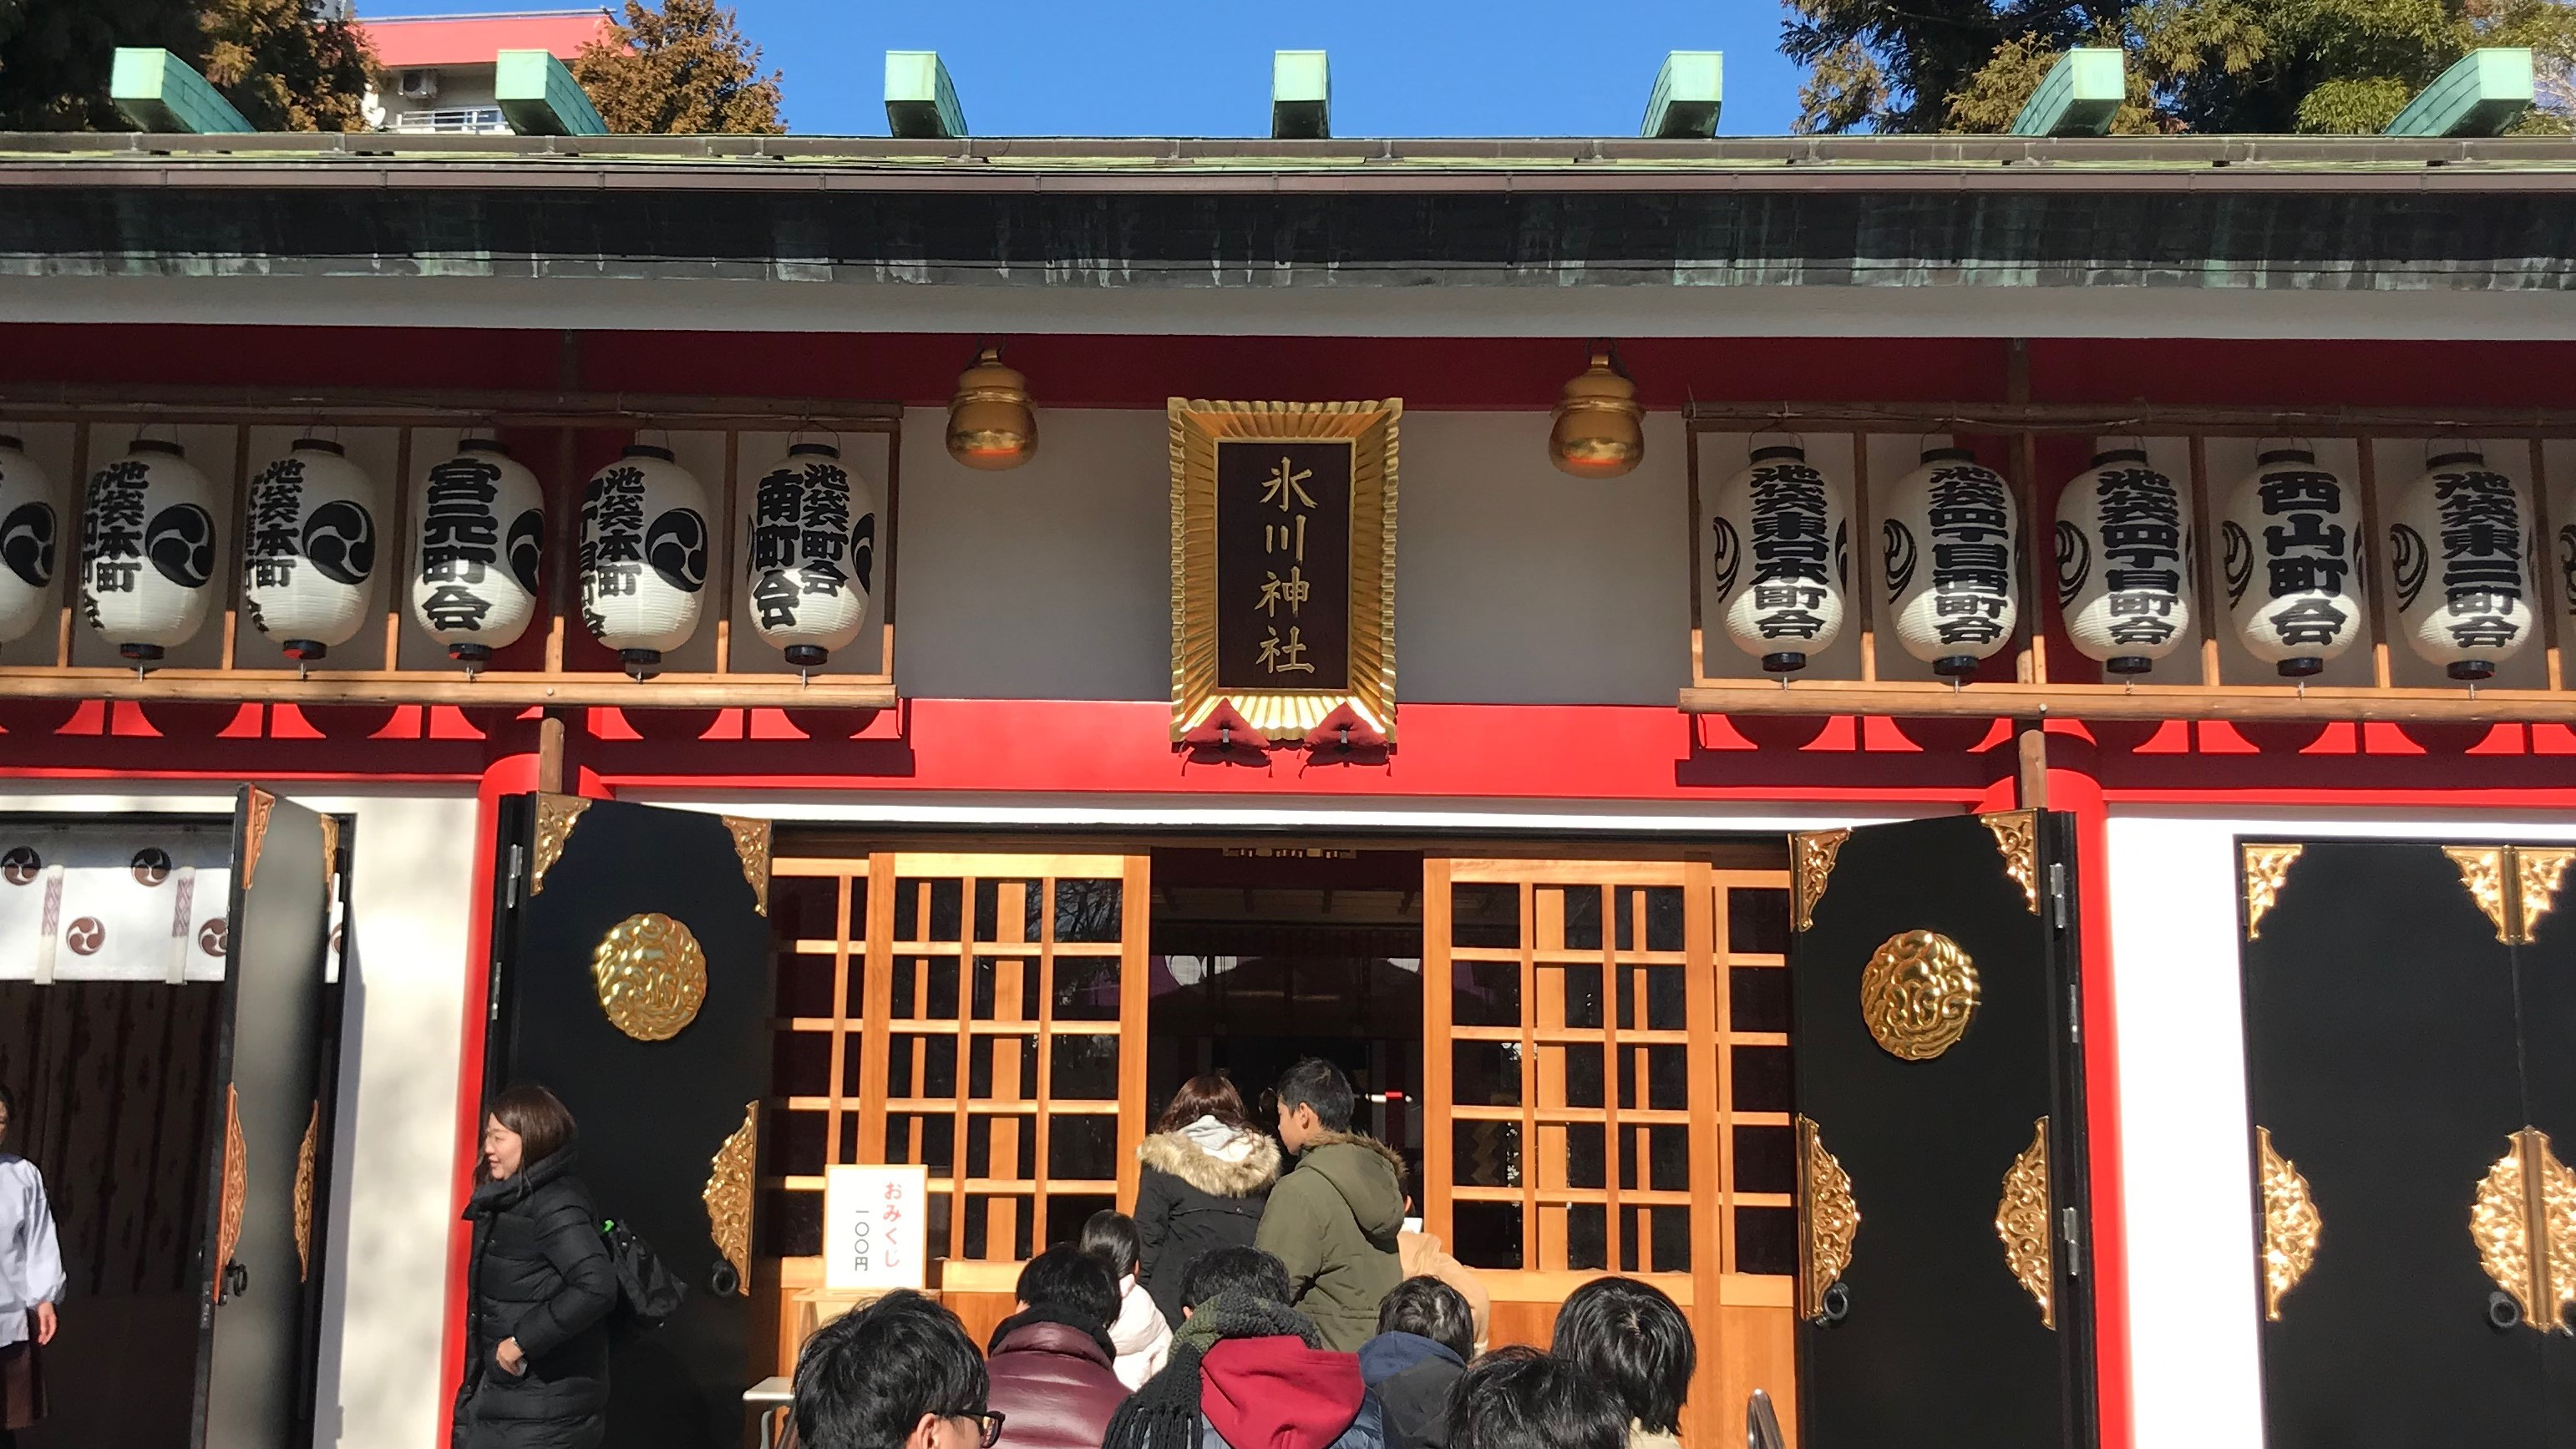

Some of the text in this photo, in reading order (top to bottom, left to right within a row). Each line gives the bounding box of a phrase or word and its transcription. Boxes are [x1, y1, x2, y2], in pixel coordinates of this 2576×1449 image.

[96, 461, 150, 593] 池袋本町
[255, 459, 306, 587] 池袋本町
[596, 466, 646, 597] 池袋本町
[753, 469, 804, 630] 南町会
[800, 464, 849, 597] 池袋町会
[1255, 456, 1318, 674] 氷川神社
[2097, 469, 2180, 645] 池袋四丁目町会
[2257, 471, 2348, 646] 西山町会
[883, 1182, 902, 1268] おみくじ
